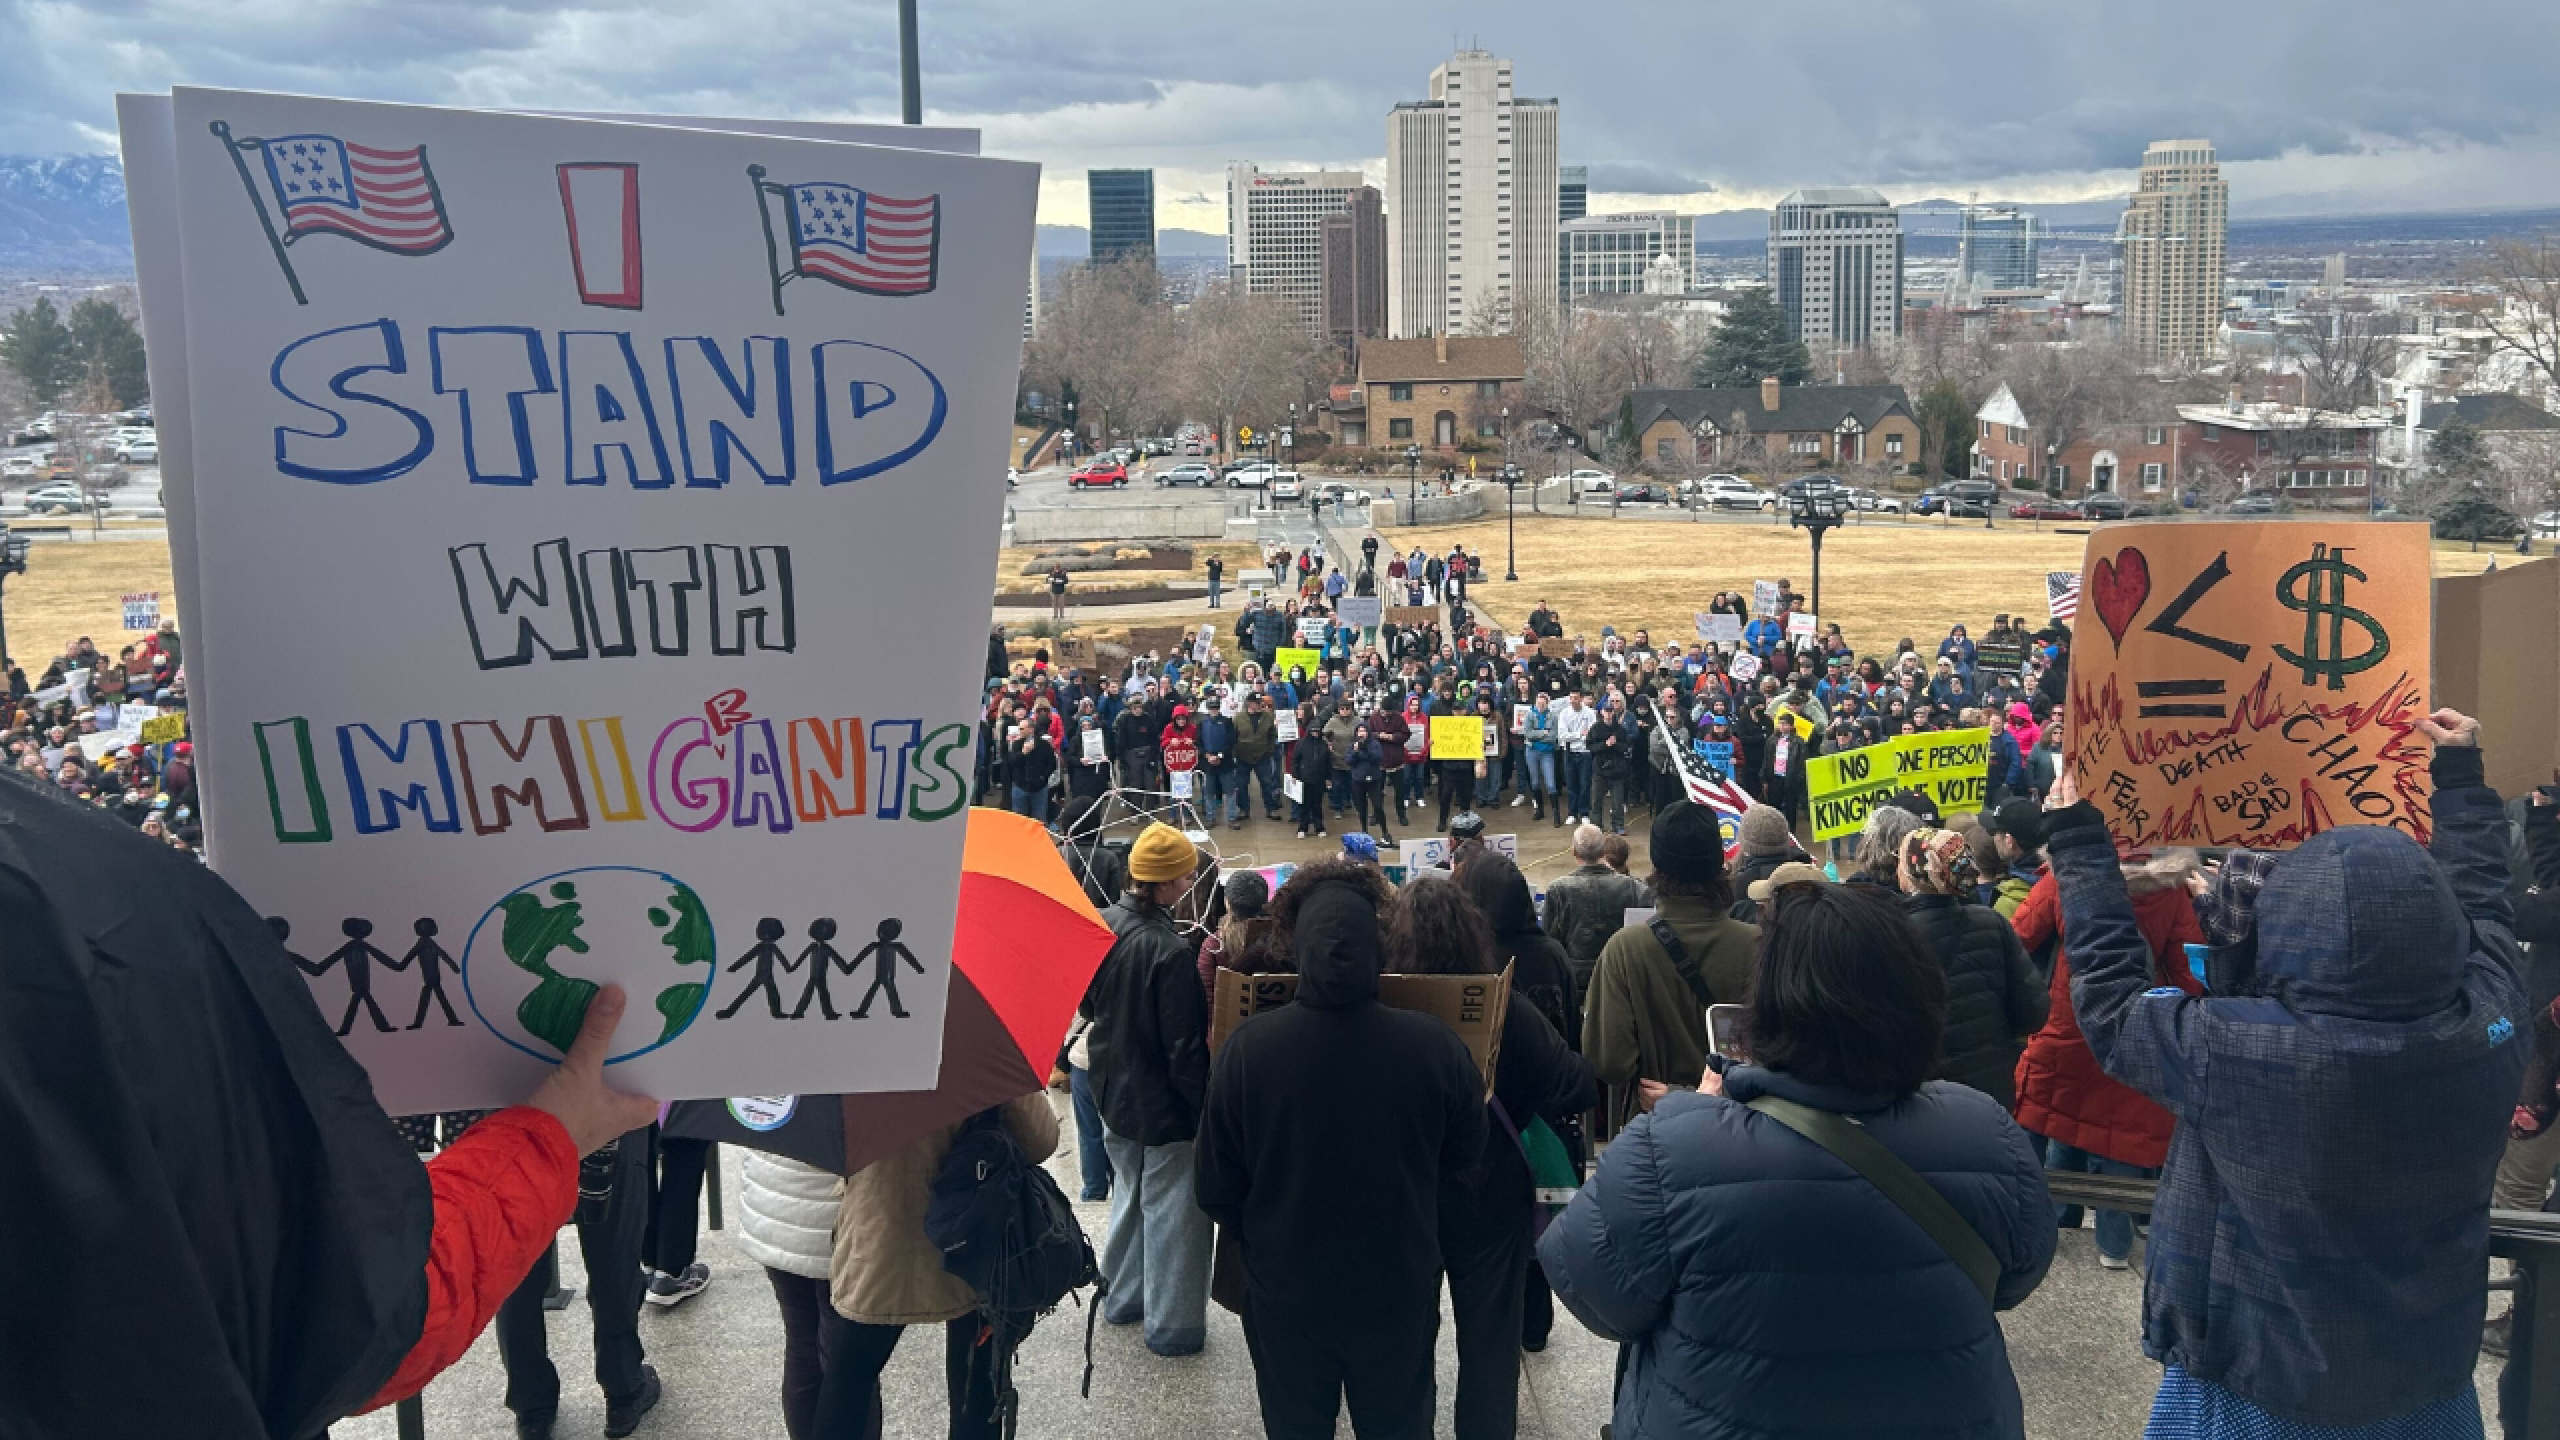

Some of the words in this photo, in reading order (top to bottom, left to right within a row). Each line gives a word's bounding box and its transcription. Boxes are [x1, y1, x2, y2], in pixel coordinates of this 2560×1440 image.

[557, 163, 643, 310] I
[270, 318, 949, 489] STAND
[448, 537, 797, 670] WITH
[1167, 750, 1194, 763] STOP
[1839, 753, 1869, 784] NO
[1929, 742, 1988, 769] PERSON
[2158, 738, 2252, 786] DEATH
[1937, 777, 1988, 805] VOTE
[2103, 769, 2149, 838] FEAR
[2212, 771, 2259, 813] BAD
[2238, 787, 2291, 831] SAD
[1461, 984, 1485, 1023] FIFO
